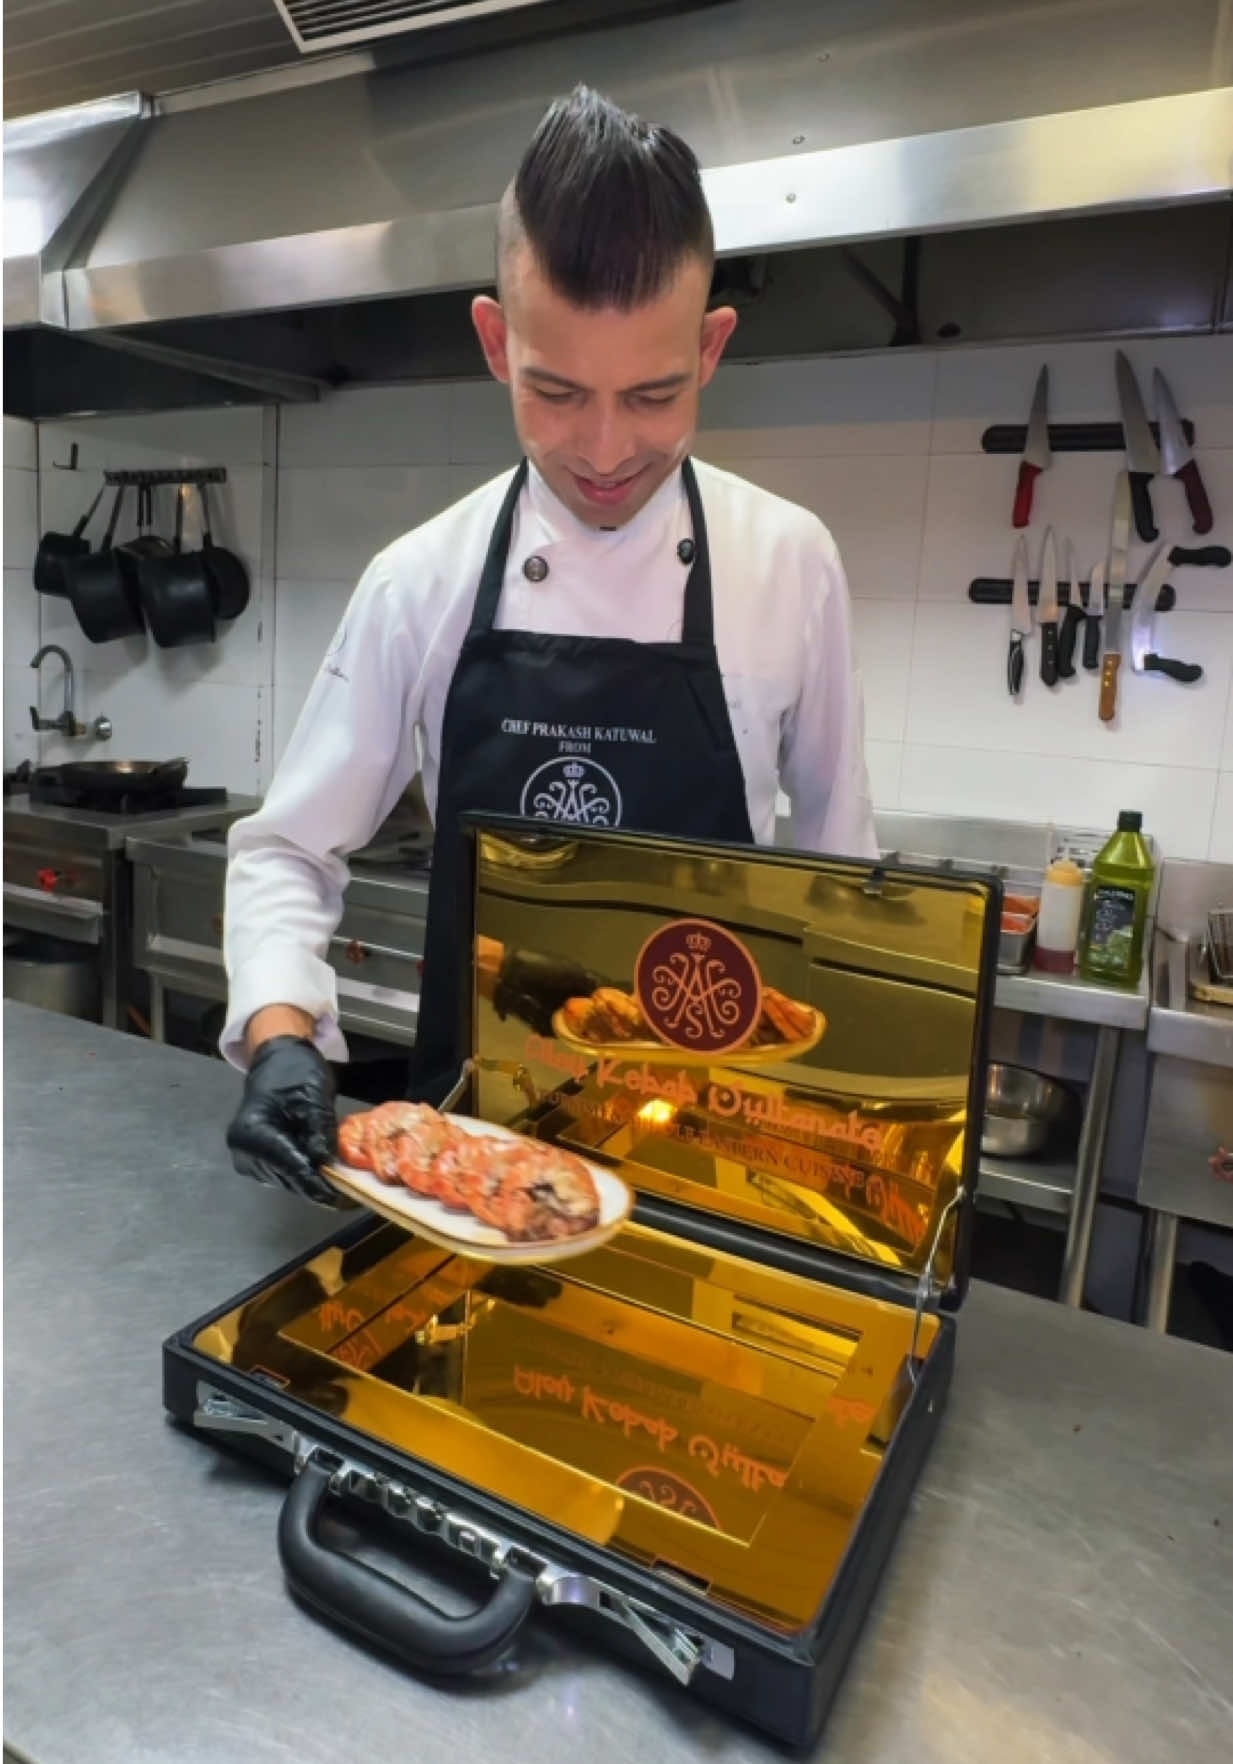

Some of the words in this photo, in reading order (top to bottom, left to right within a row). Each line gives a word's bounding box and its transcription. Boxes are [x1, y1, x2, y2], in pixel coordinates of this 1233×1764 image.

[502, 719, 531, 735] CHEF
[533, 723, 592, 739] PRAKASH
[594, 726, 657, 744] KATUWAL
[558, 740, 592, 753] FROM
